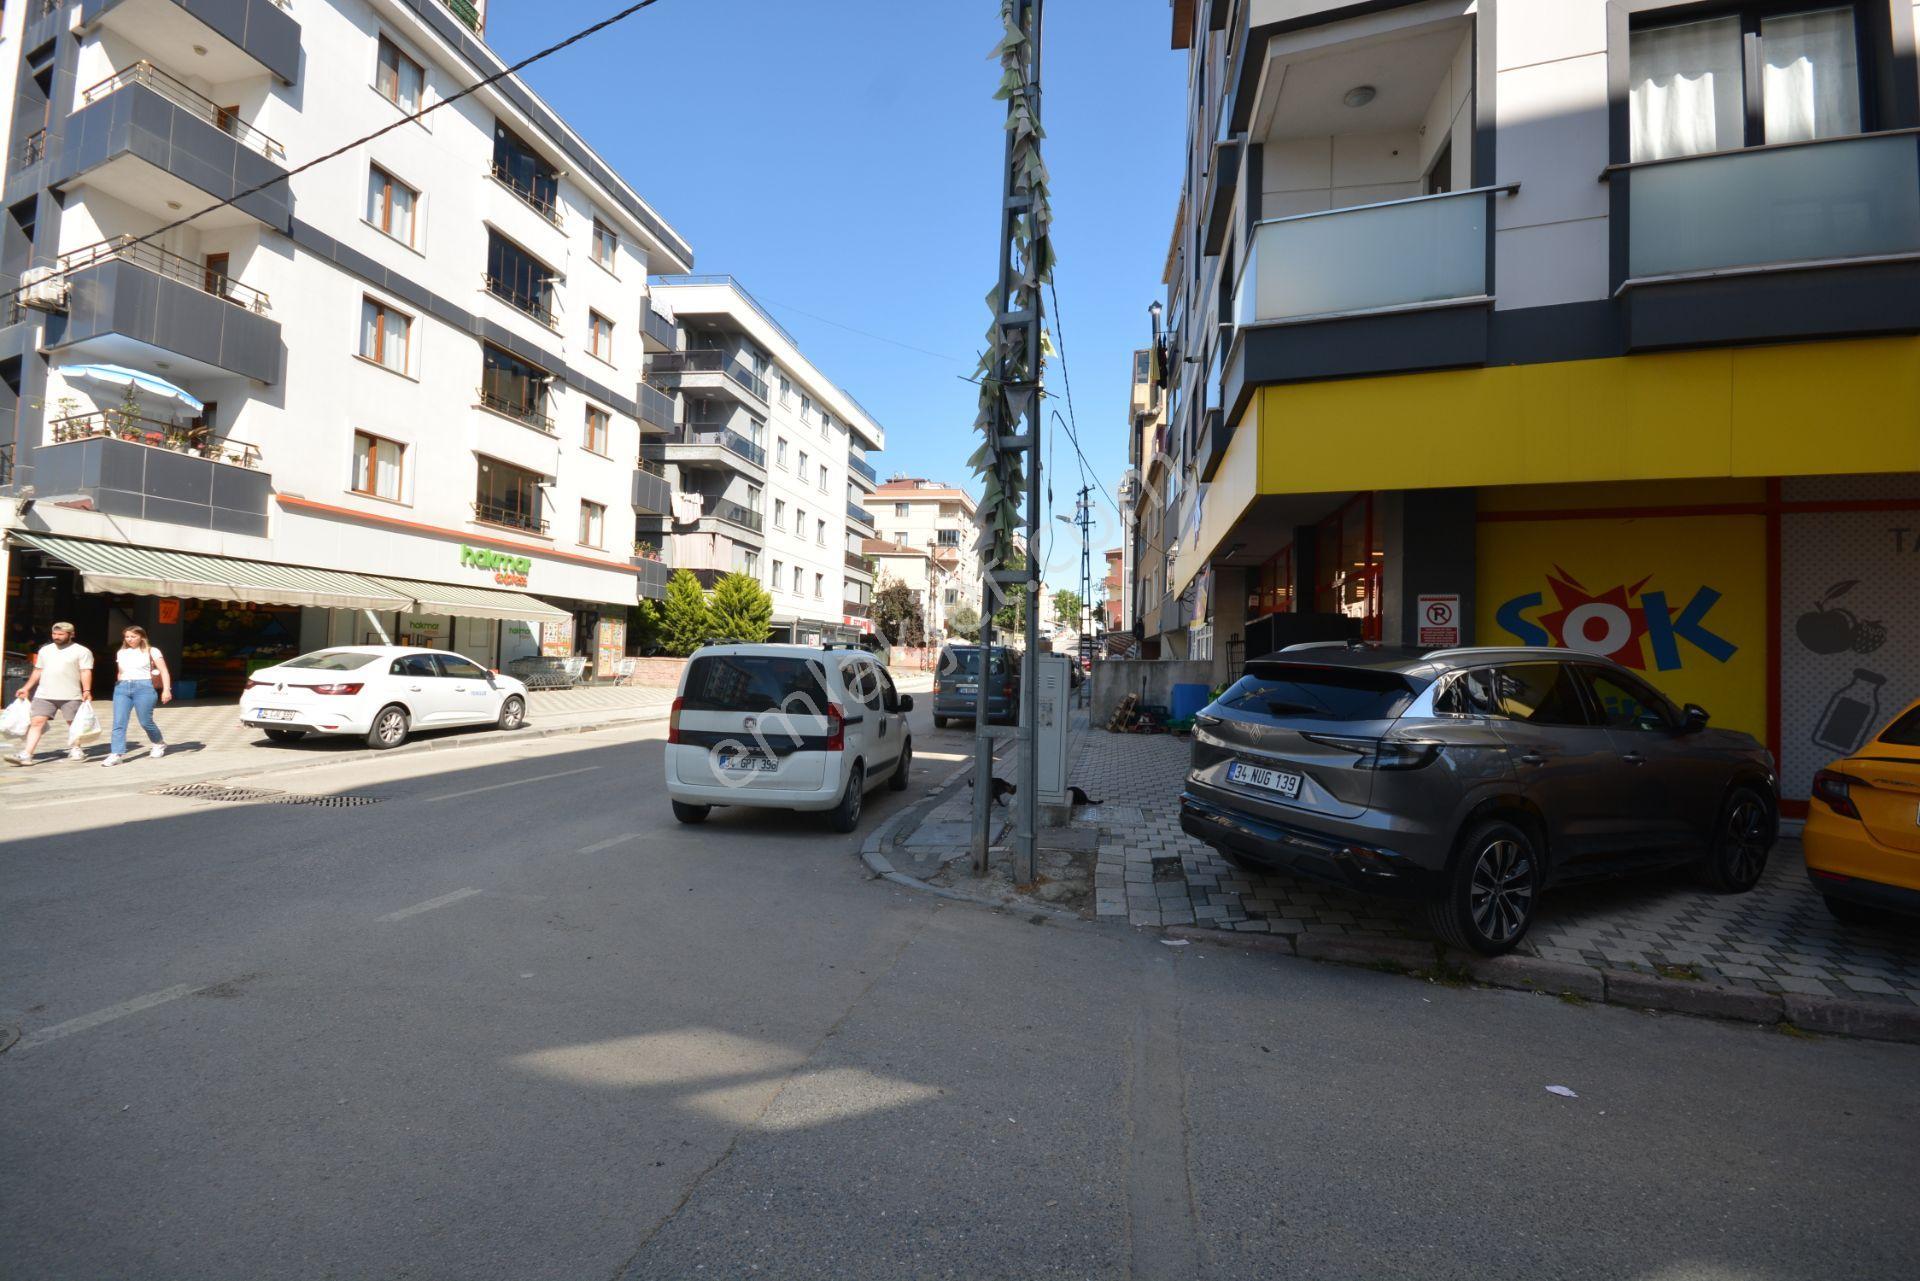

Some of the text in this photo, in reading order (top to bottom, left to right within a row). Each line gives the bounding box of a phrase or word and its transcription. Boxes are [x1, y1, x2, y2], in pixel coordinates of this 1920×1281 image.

[460, 543, 532, 575] hakmar
[740, 758, 757, 768] GPT
[1235, 765, 1297, 792] 34 NUG 139
